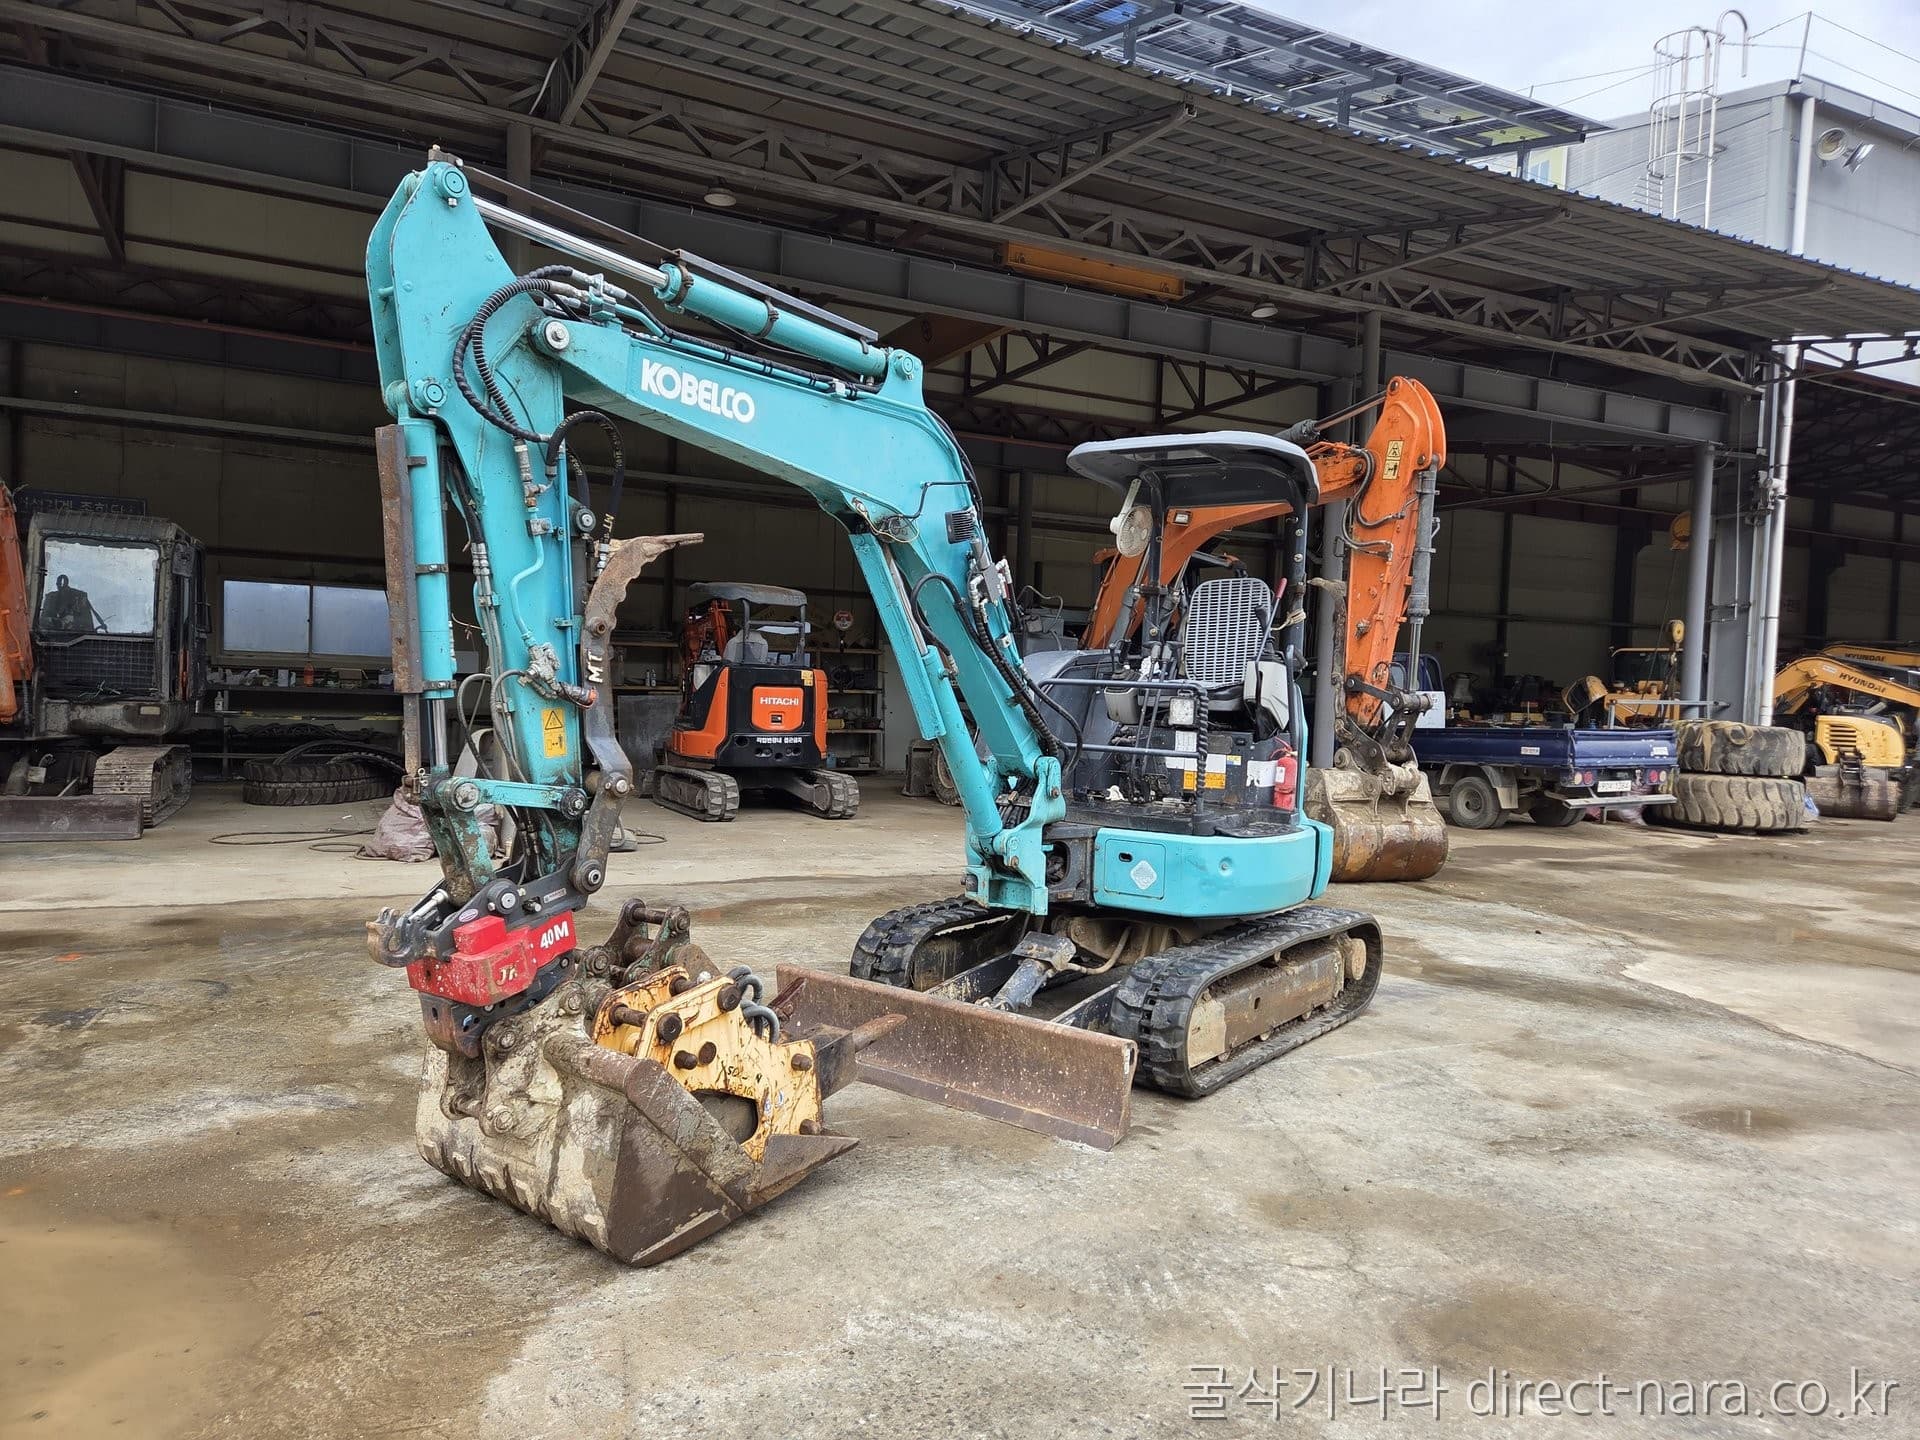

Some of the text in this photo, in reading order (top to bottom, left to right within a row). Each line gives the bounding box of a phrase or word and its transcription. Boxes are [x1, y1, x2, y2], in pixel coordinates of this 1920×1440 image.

[641, 358, 755, 423] KOBELCO
[1844, 653, 1886, 662] HYUNDAI
[1839, 672, 1887, 693] HYUNDAI
[760, 696, 799, 706] HITACHI
[540, 920, 569, 950] 40M
